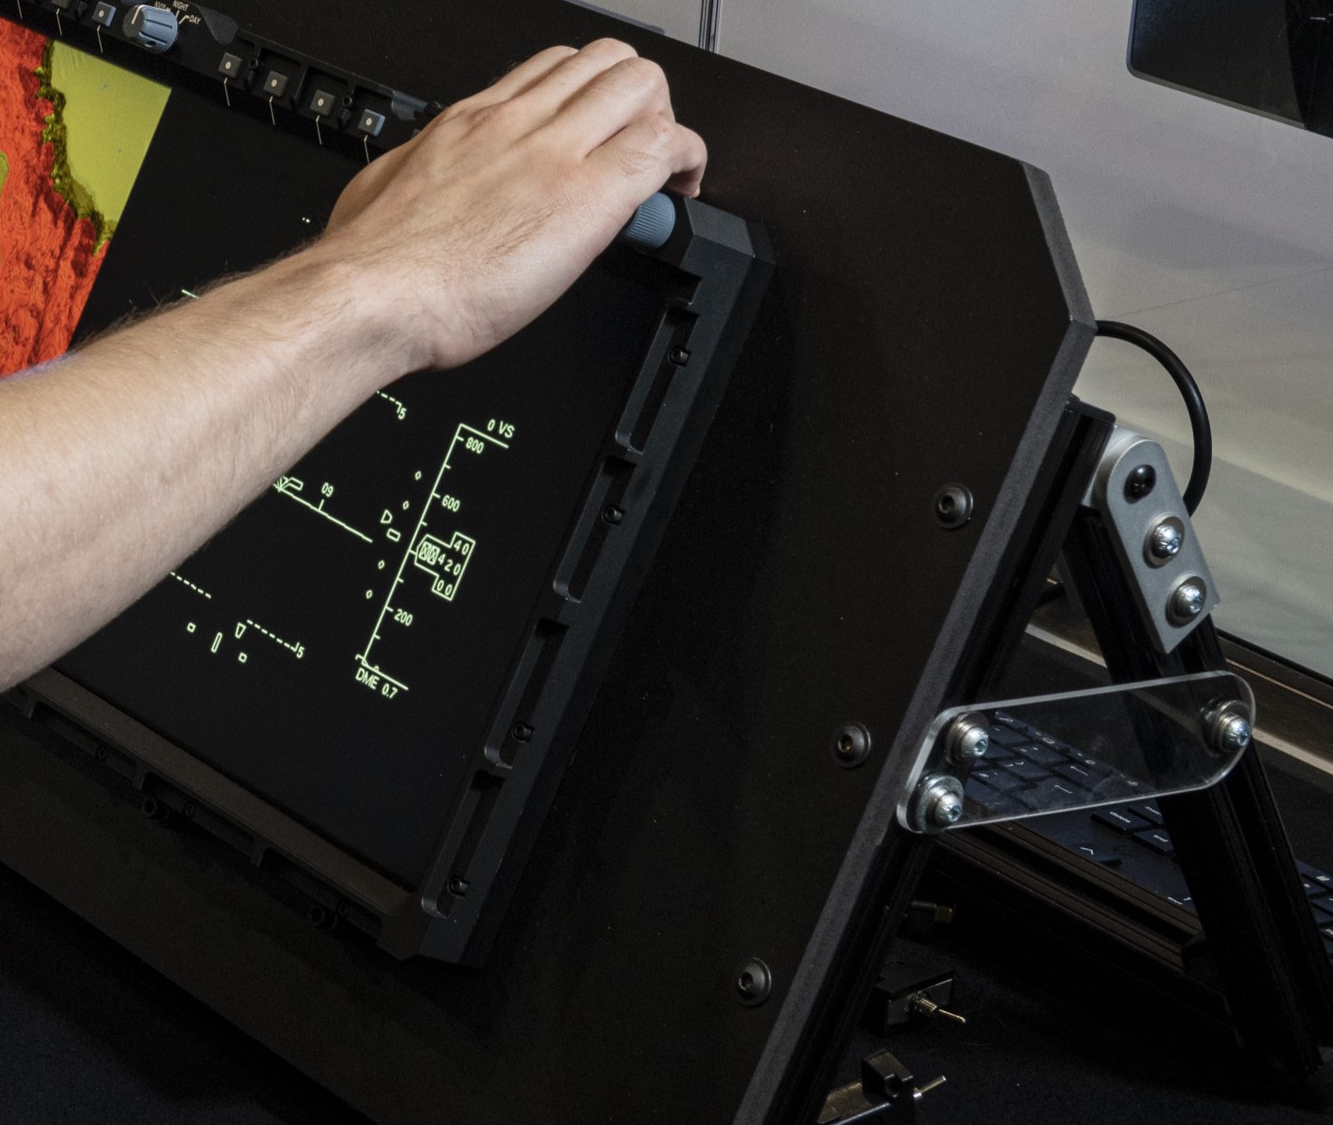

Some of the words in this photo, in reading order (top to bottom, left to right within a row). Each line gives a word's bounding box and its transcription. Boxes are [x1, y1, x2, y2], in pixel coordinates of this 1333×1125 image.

[172, 0, 189, 11] NIGHT
[189, 14, 201, 25] DAY
[398, 407, 407, 420] 5
[487, 419, 495, 431] 0
[499, 421, 515, 439] VS
[465, 436, 484, 454] 800
[441, 494, 460, 512] 600
[394, 608, 413, 626] 200
[296, 645, 305, 659] 5
[355, 667, 380, 690] DME
[382, 683, 399, 699] 0.7
